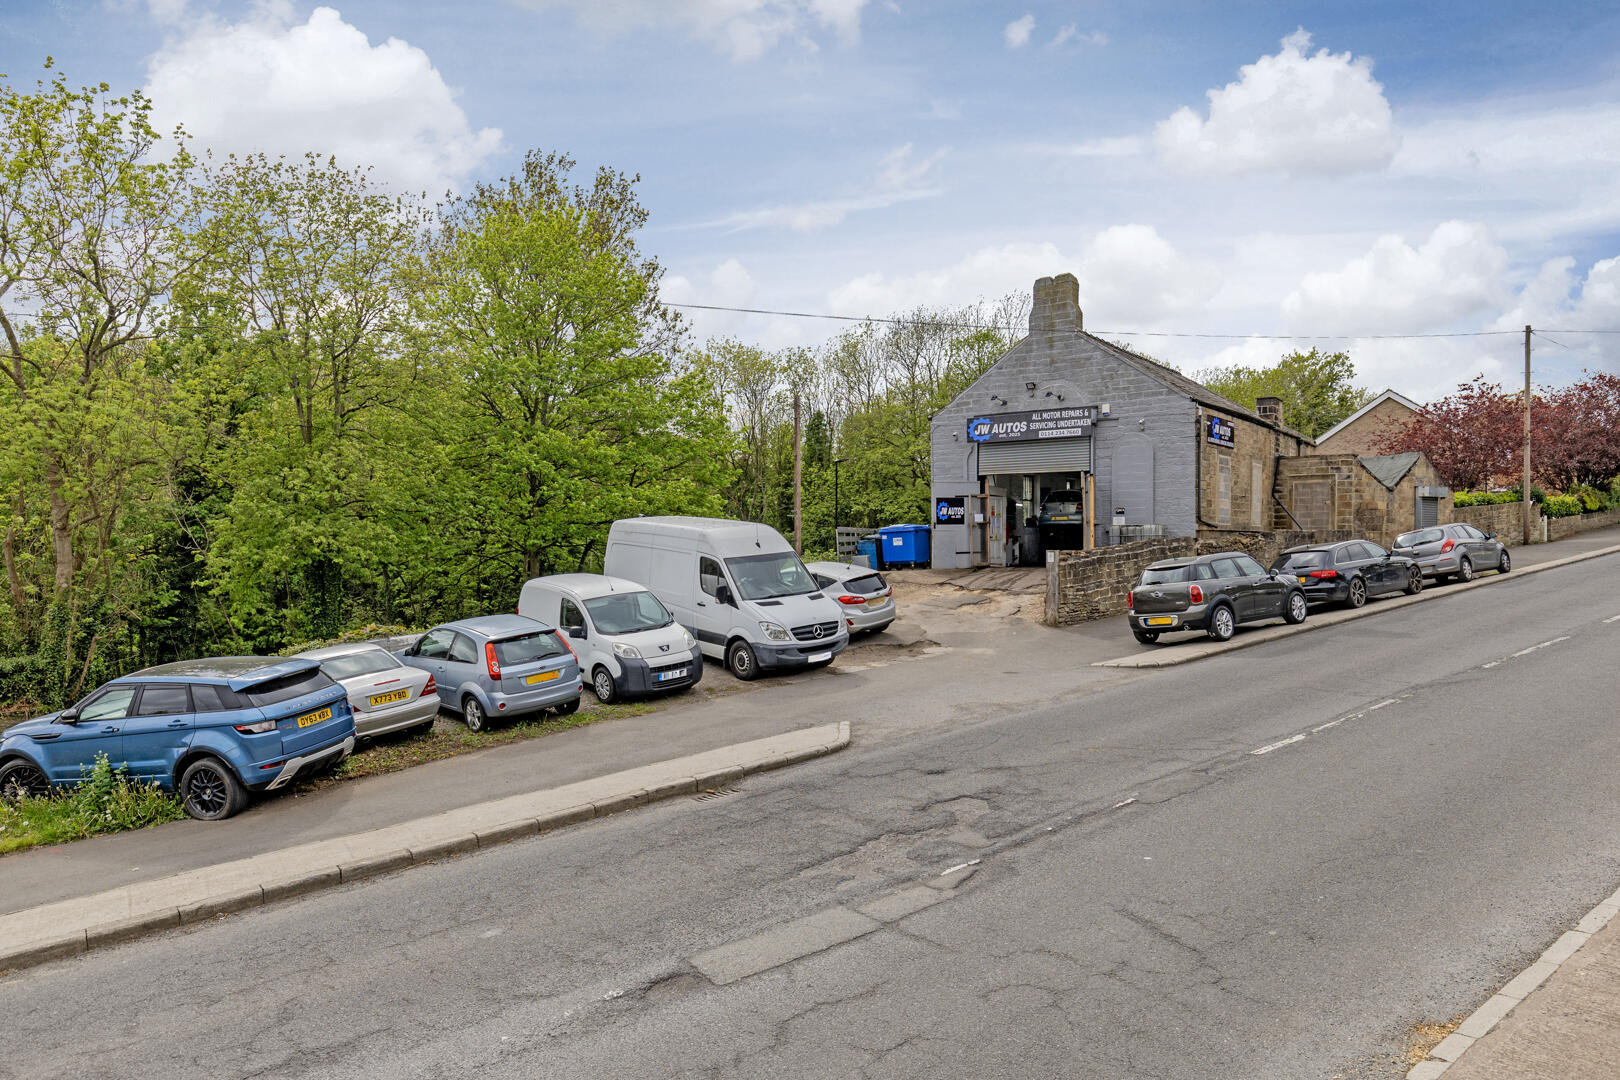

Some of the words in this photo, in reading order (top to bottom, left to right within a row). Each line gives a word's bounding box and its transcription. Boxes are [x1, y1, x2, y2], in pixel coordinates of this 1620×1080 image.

[1042, 412, 1061, 420] MOTOR
[1062, 410, 1083, 418] REPAIRS
[974, 423, 990, 436] JW
[992, 421, 1027, 434] AUTOS
[1030, 421, 1056, 430] SERVICING
[1057, 418, 1091, 428] UNDERTAKEN
[948, 506, 964, 516] AUTOS
